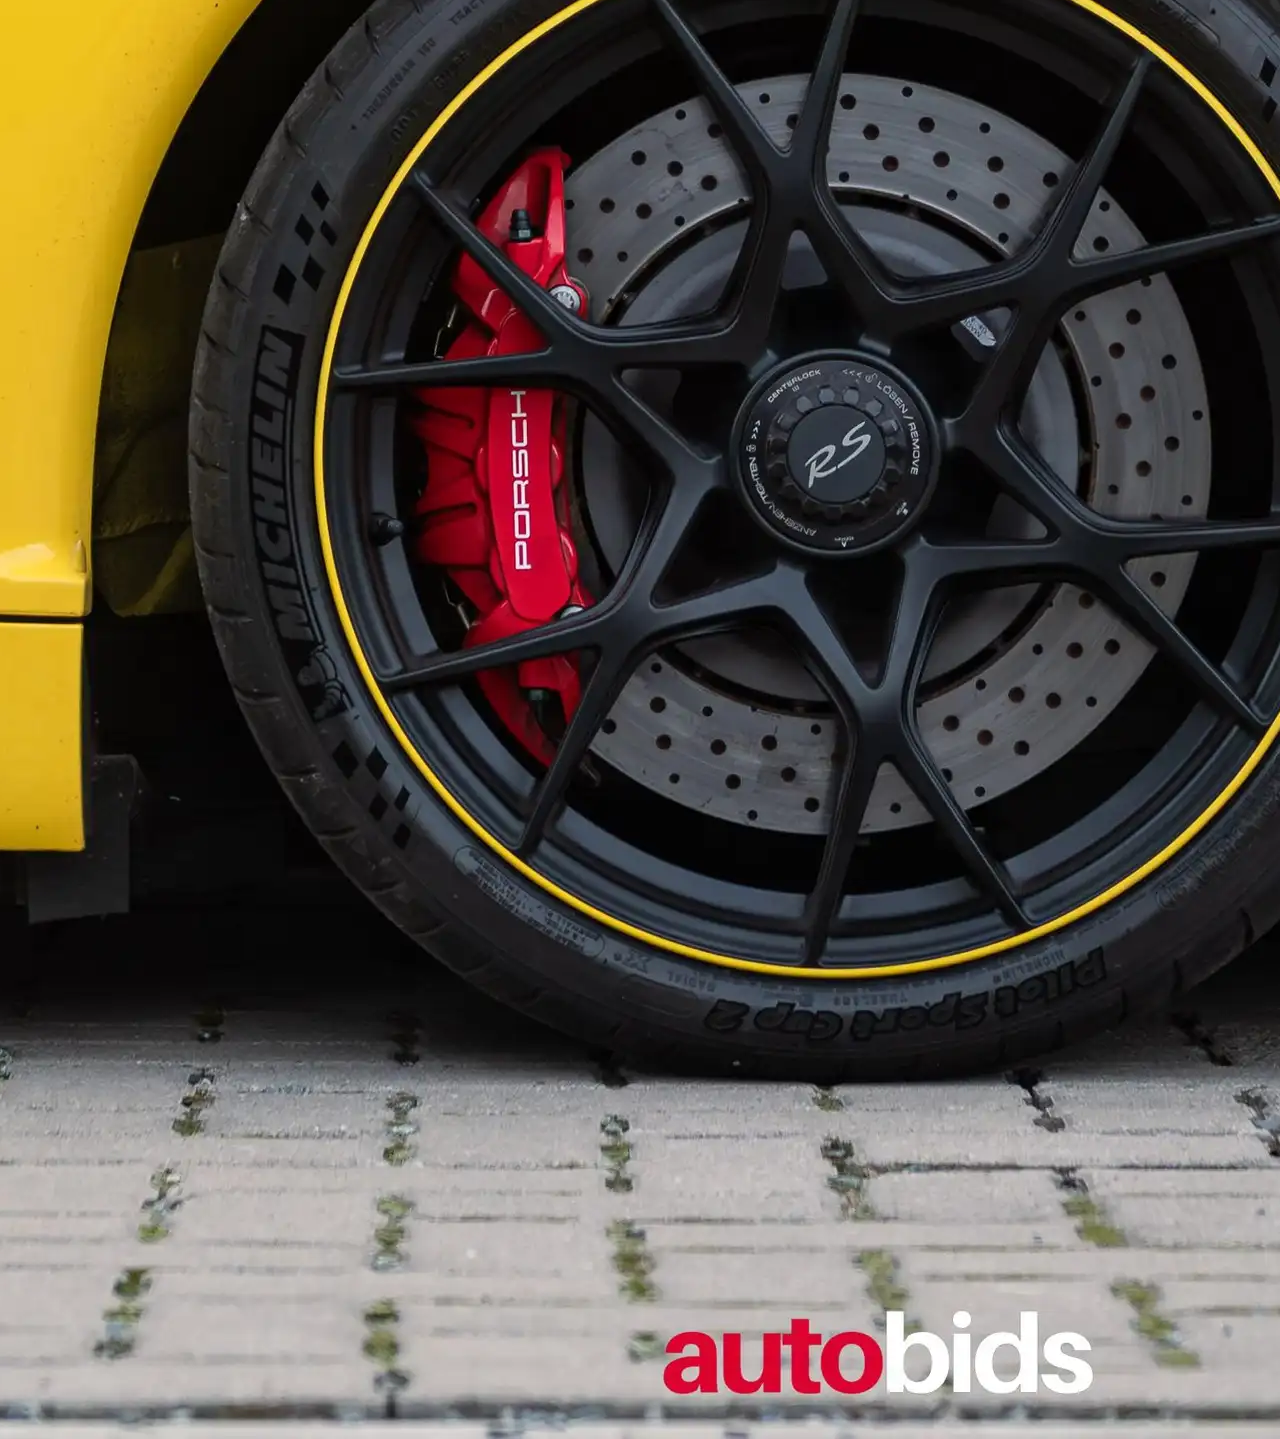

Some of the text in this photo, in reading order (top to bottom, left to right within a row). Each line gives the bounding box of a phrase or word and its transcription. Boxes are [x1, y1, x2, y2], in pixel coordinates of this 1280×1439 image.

[767, 368, 822, 404] CENTERLOCK
[510, 390, 532, 570] PORSCH
[805, 421, 872, 489] RS
[253, 329, 312, 643] MICHELIN
[990, 947, 1107, 1018] Pilot
[703, 998, 750, 1035] 2
[753, 1001, 844, 1041] Cup
[850, 989, 993, 1042] Sport
